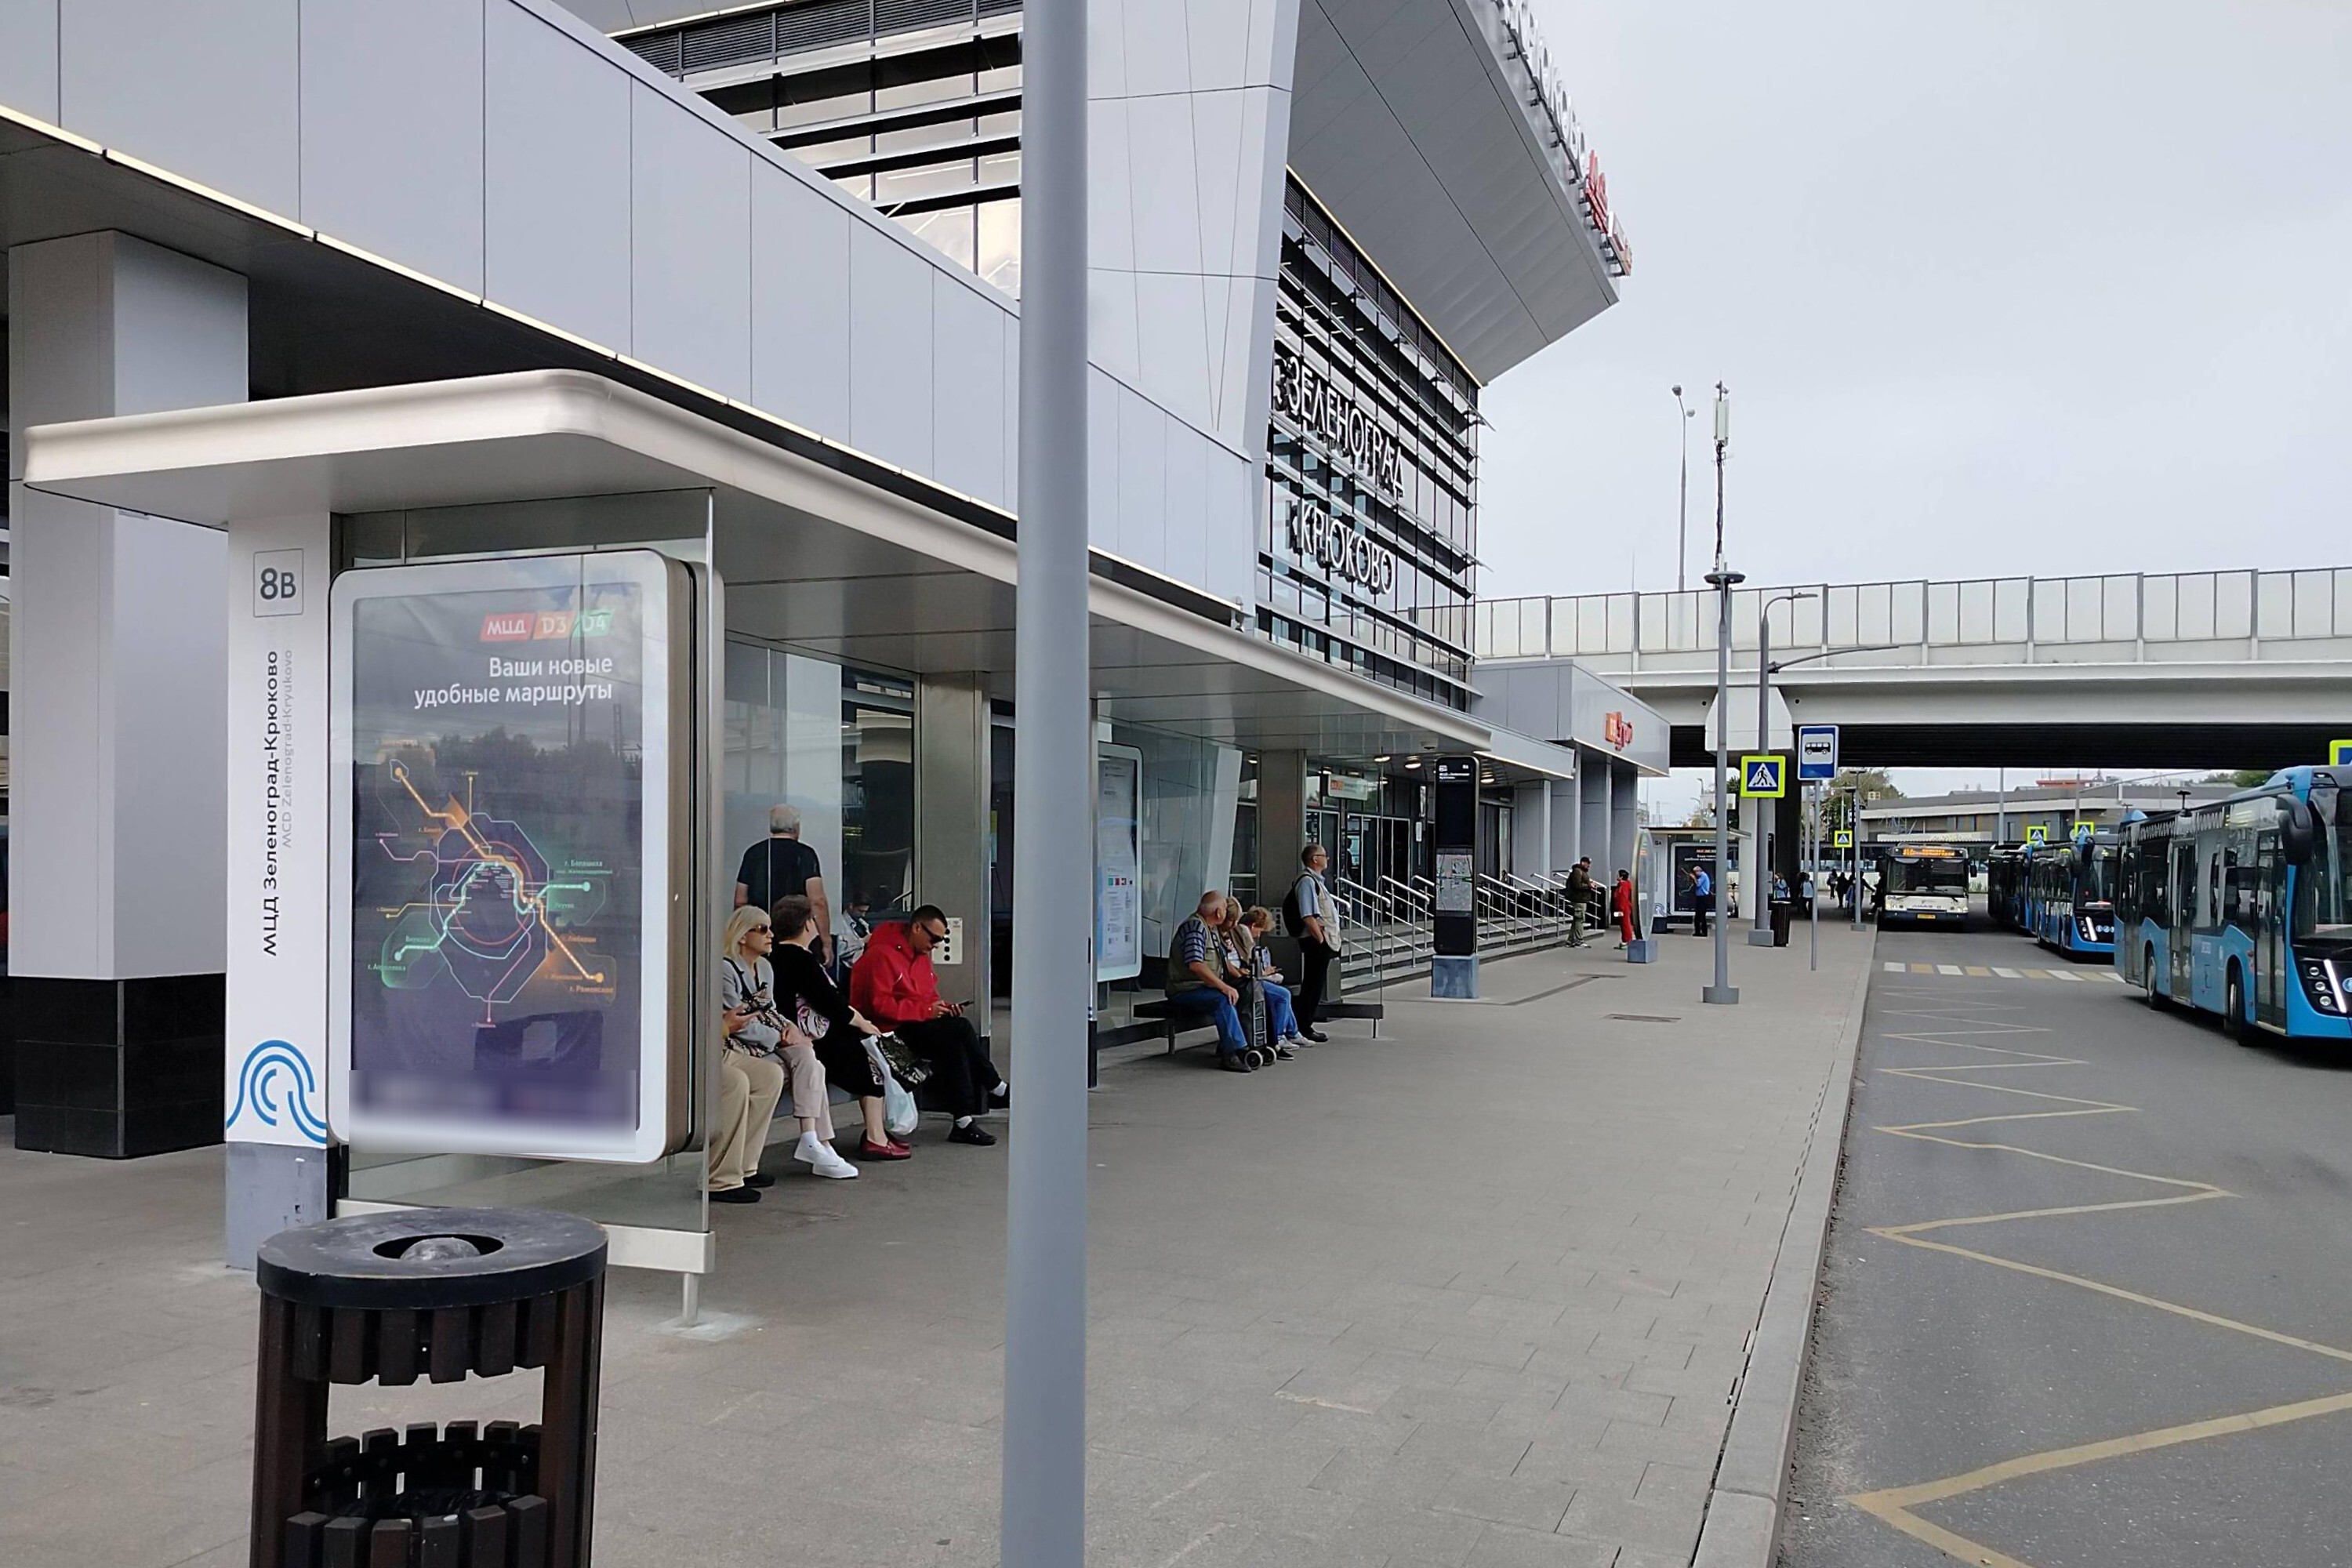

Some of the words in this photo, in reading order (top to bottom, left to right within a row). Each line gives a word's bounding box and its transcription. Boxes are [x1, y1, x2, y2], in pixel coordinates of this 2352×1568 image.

[1301, 499, 1394, 595] КРЮКОВО
[542, 616, 568, 633] D3
[489, 657, 542, 677] Ваши
[549, 658, 613, 675] новые
[414, 683, 499, 710] удобные
[505, 684, 612, 706] маршруты
[282, 649, 294, 807] Zelenograd-Kryukovo
[263, 651, 280, 890] Зеленоград-Крюково
[282, 811, 292, 848] MCD
[263, 896, 279, 956] МЦД
